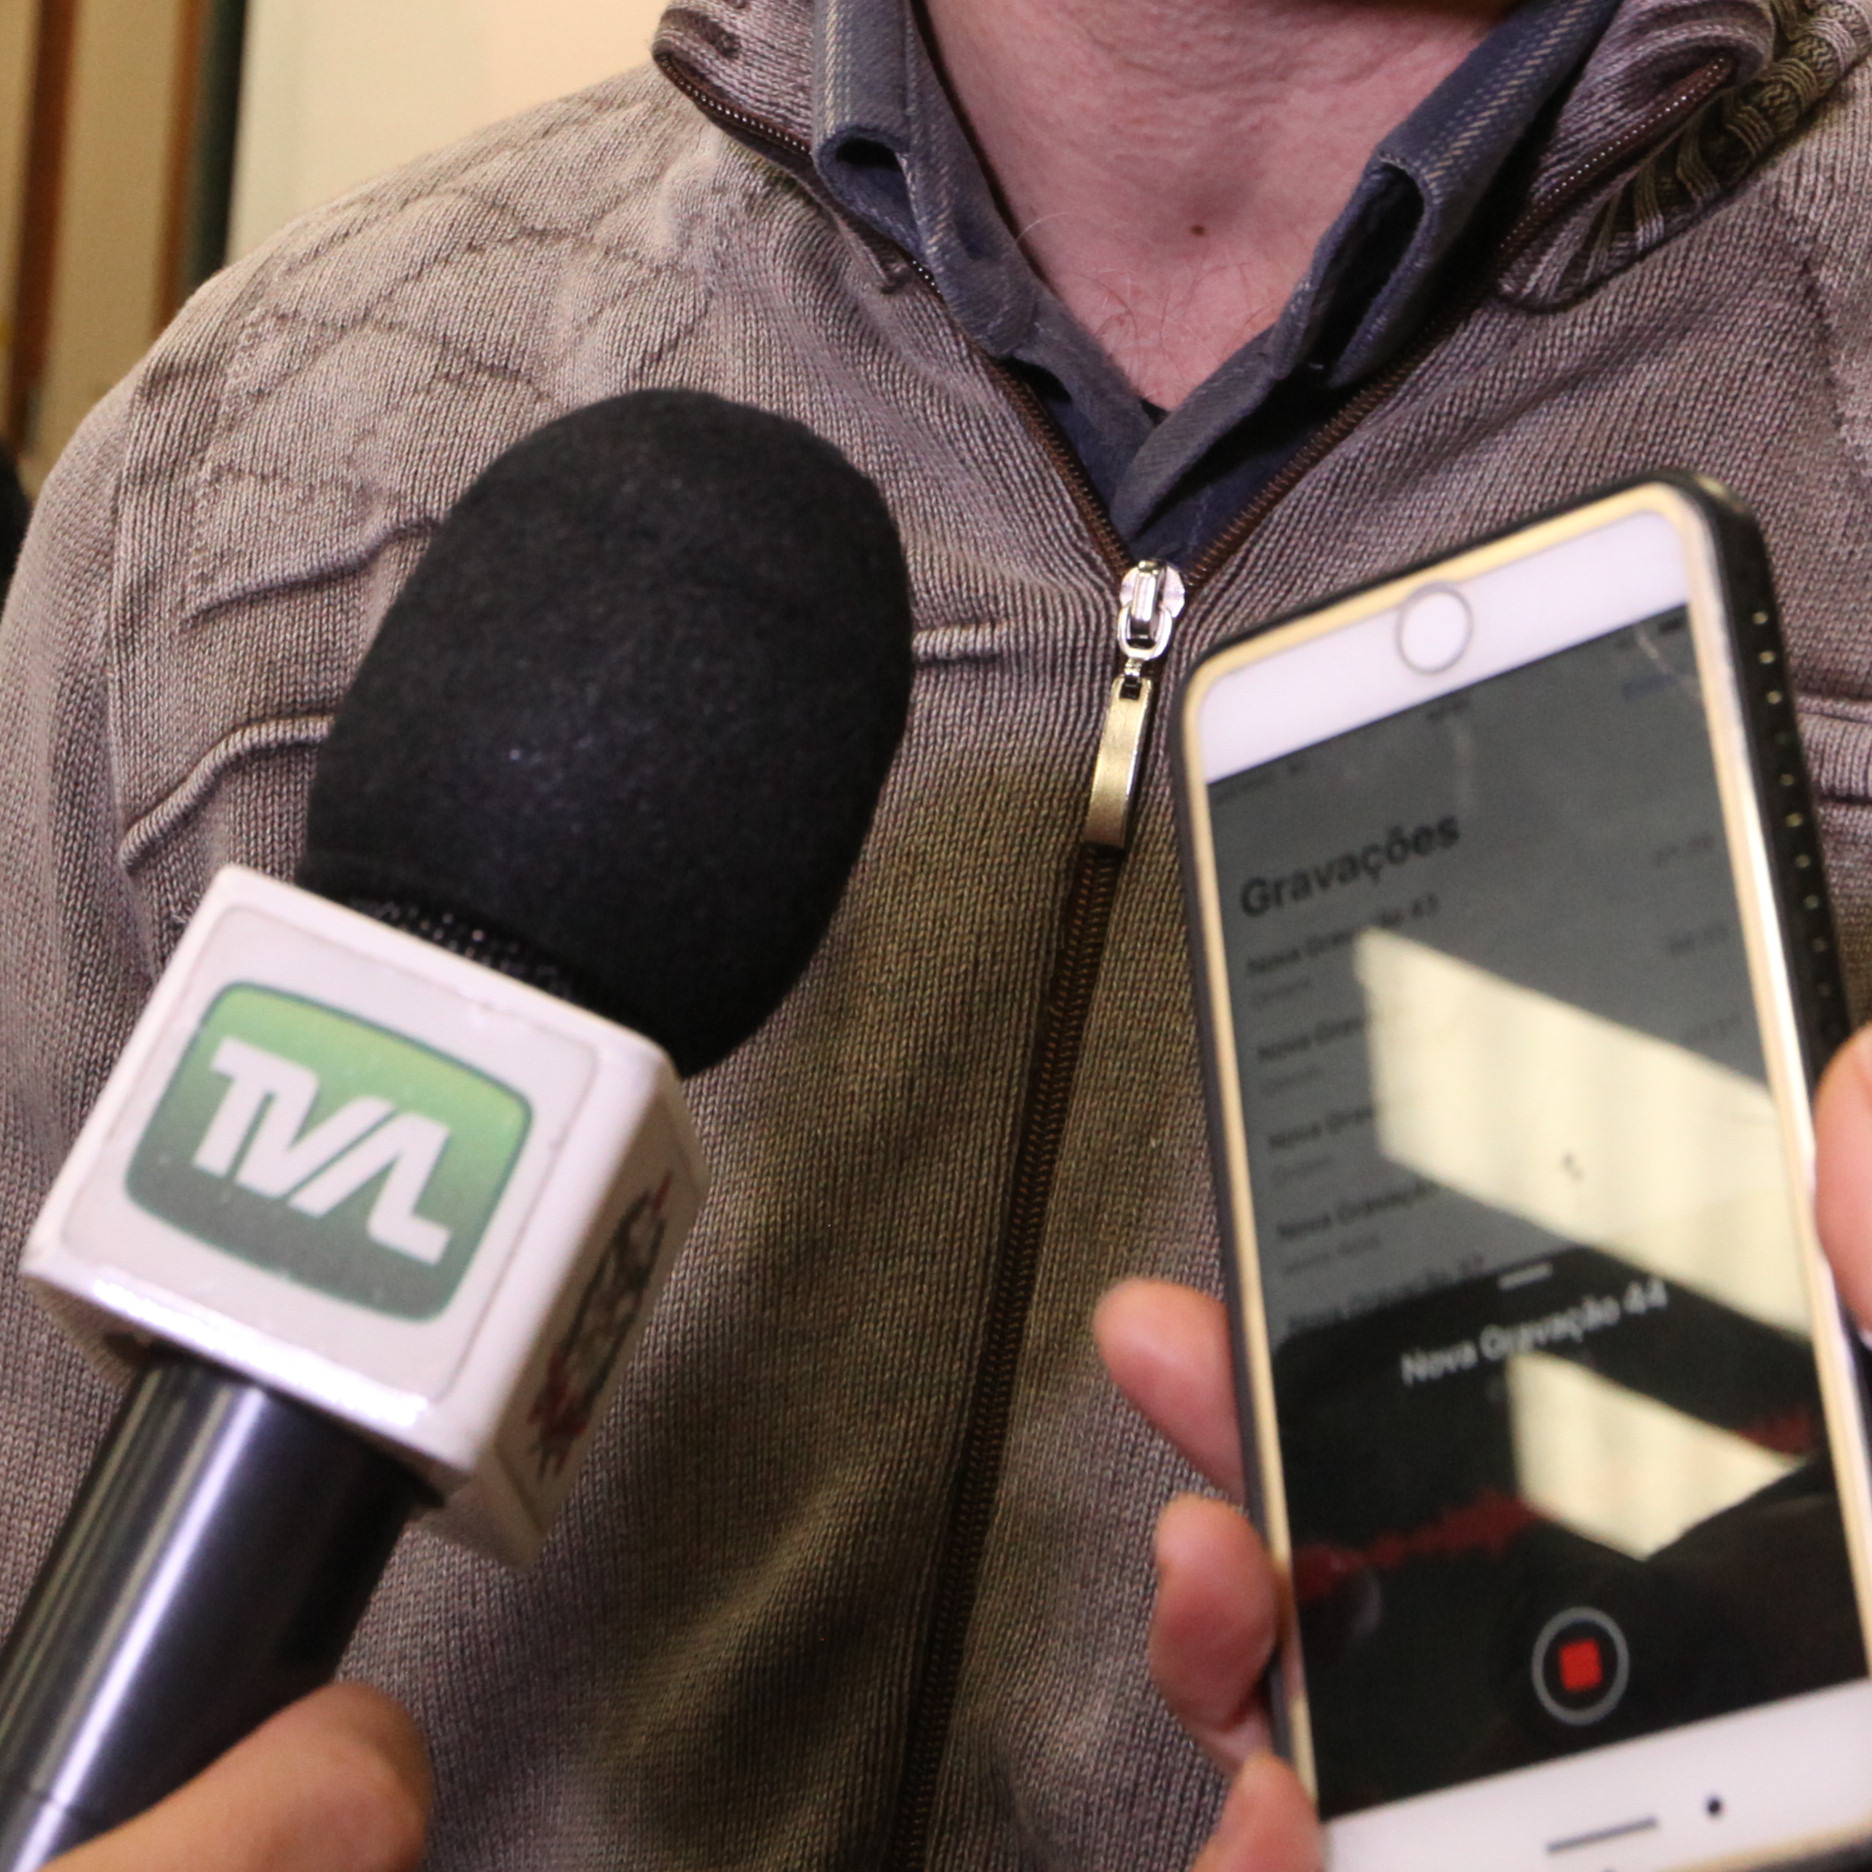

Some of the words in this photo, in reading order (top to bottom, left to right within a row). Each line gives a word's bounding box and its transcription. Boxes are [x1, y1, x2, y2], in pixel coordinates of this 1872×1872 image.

[1240, 815, 1460, 919] Gravações
[1401, 1339, 1477, 1387] Nova
[1623, 1278, 1669, 1315] 44
